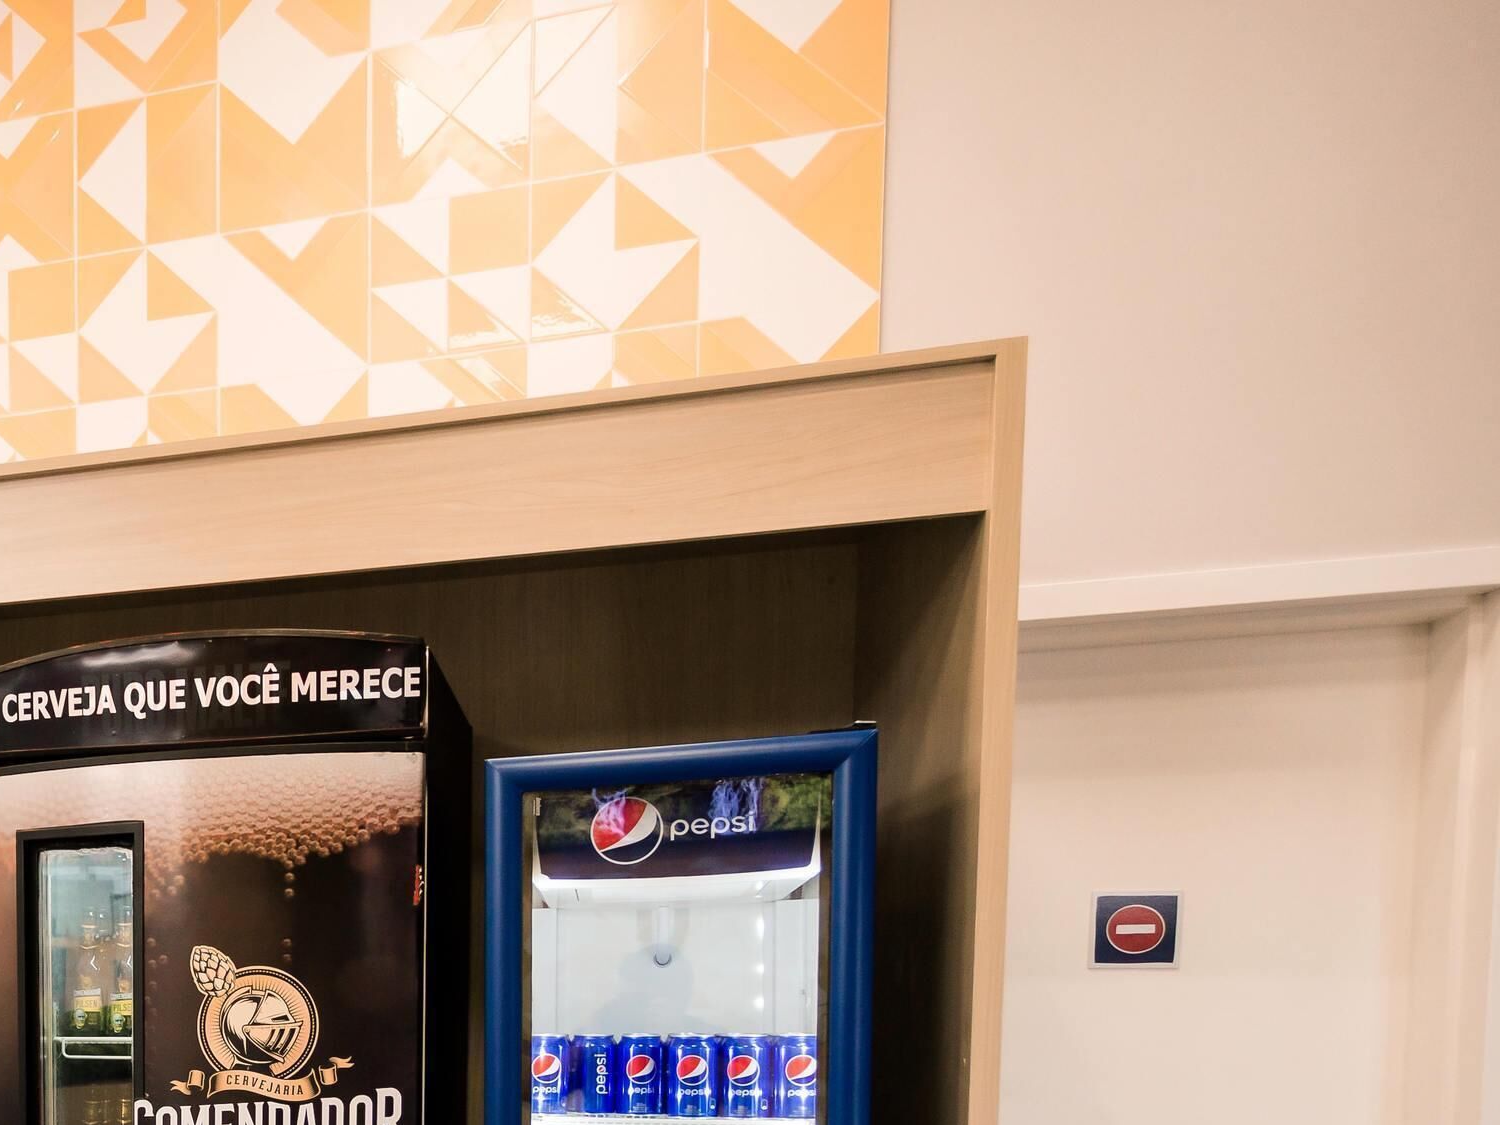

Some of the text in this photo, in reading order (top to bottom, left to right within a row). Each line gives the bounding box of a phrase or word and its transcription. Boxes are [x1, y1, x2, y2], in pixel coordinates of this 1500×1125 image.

[2, 686, 116, 723] CERVEJA
[123, 679, 187, 719] QUE
[194, 663, 280, 708] VOCÊ
[291, 667, 421, 703] MERECE
[669, 810, 756, 841] pepsi
[225, 1074, 305, 1097] CERVEJARIA
[596, 1052, 608, 1095] pepsi
